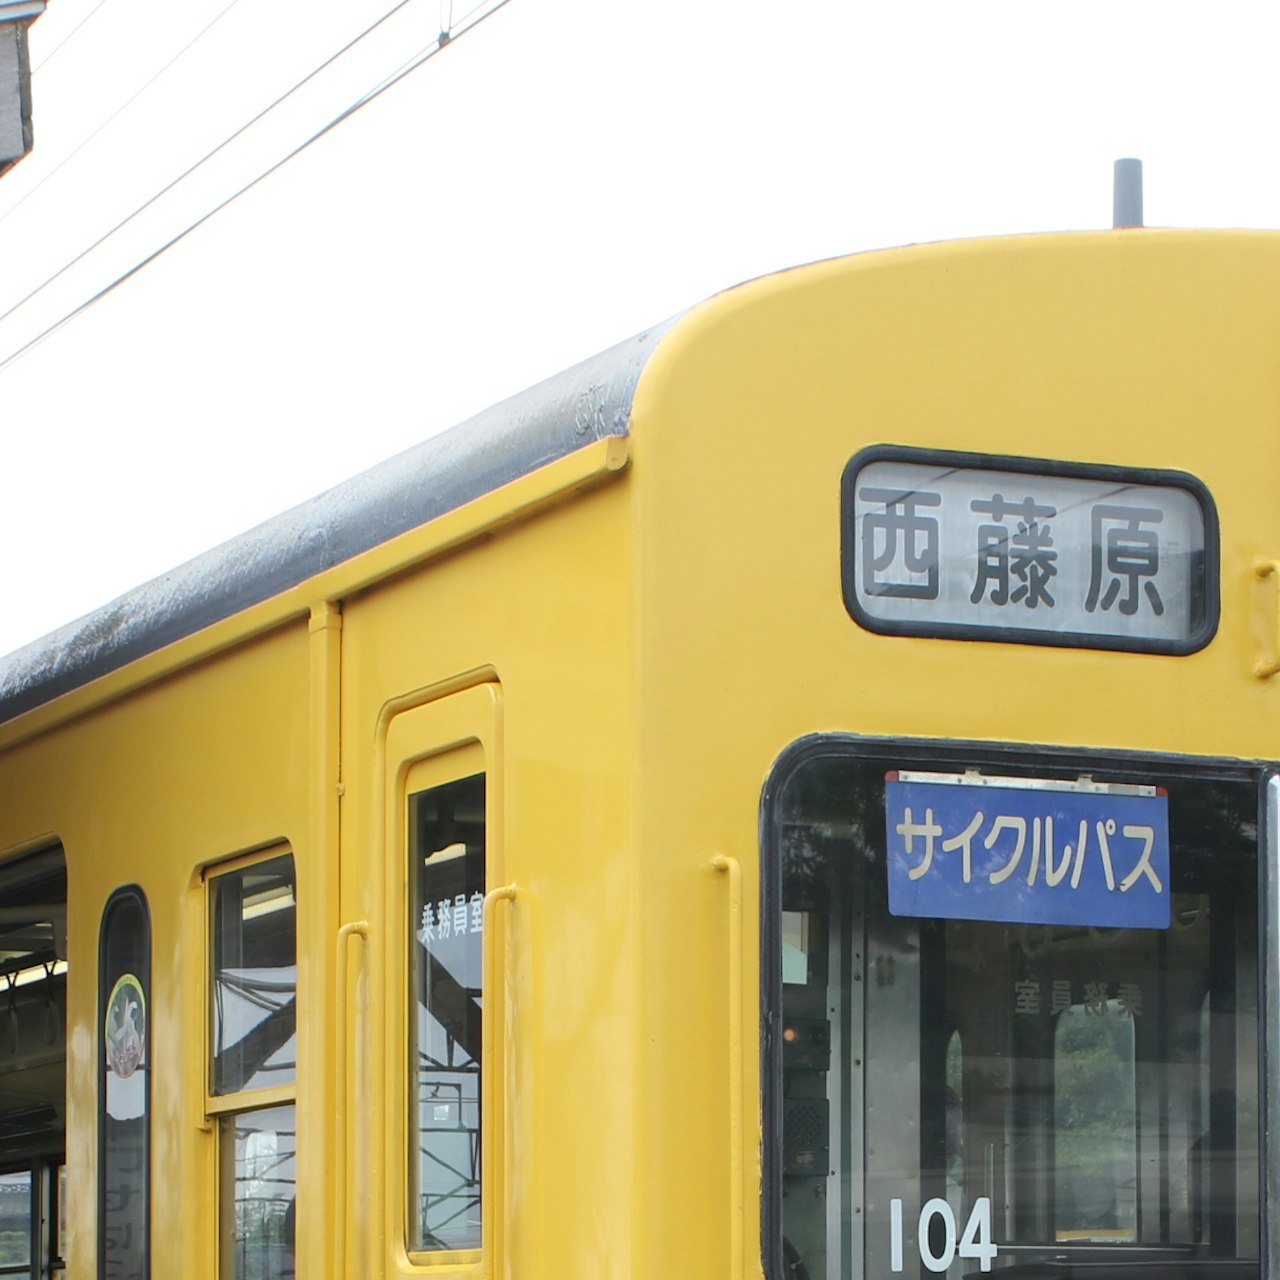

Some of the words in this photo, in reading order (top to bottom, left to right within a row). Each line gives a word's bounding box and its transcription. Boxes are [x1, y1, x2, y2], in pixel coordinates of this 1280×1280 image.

[858, 486, 1165, 617] 西藤原
[896, 806, 1163, 894] サイクルパス
[420, 890, 485, 945] 乗務員室
[889, 1196, 999, 1273] 104
